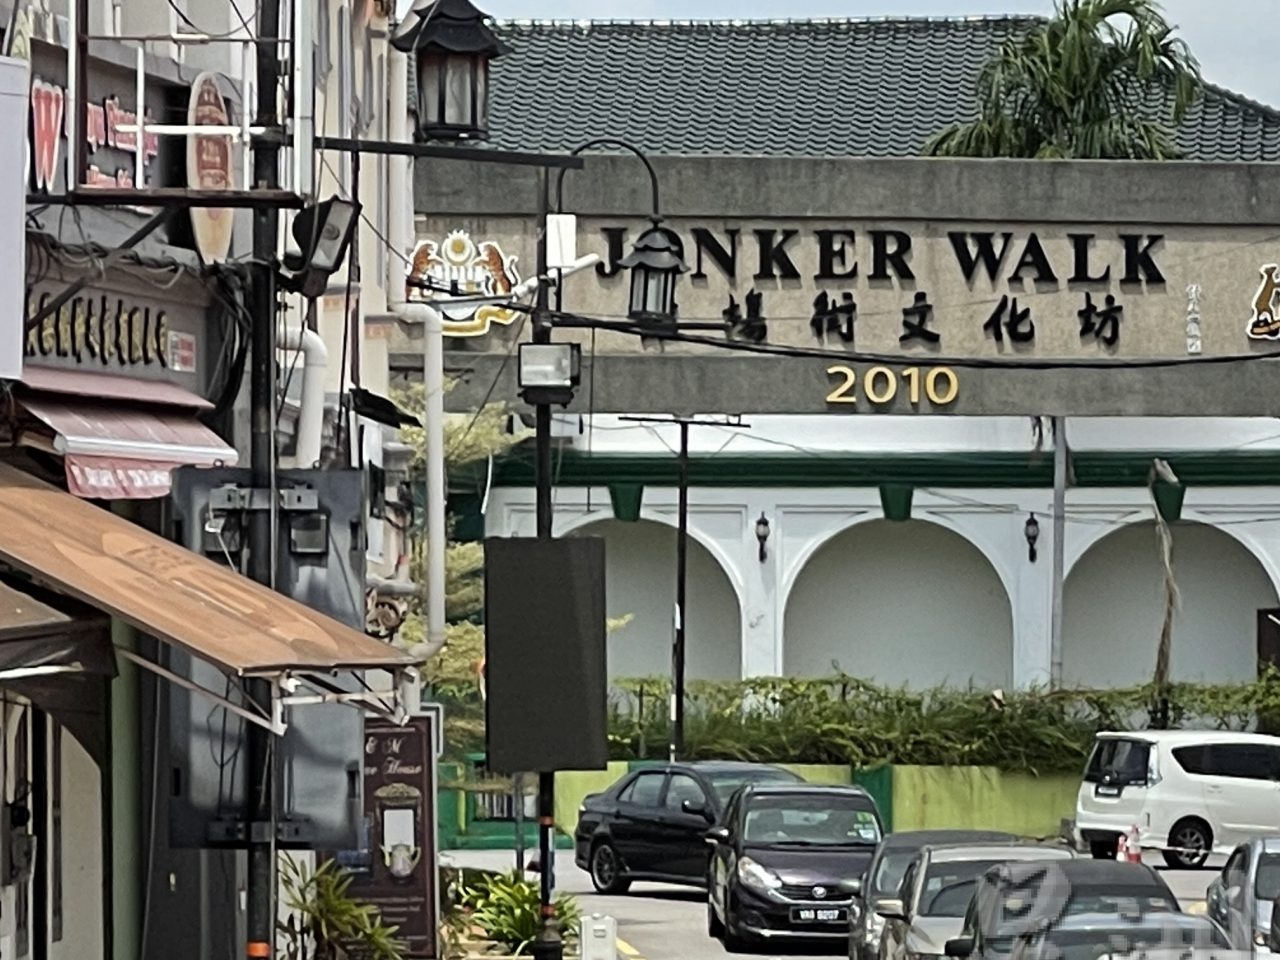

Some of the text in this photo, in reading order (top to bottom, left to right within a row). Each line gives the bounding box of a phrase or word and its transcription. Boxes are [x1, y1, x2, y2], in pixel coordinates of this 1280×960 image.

[947, 231, 1166, 284] WALK
[628, 288, 1124, 346] 場街文化坊
[826, 366, 959, 404] 2010
